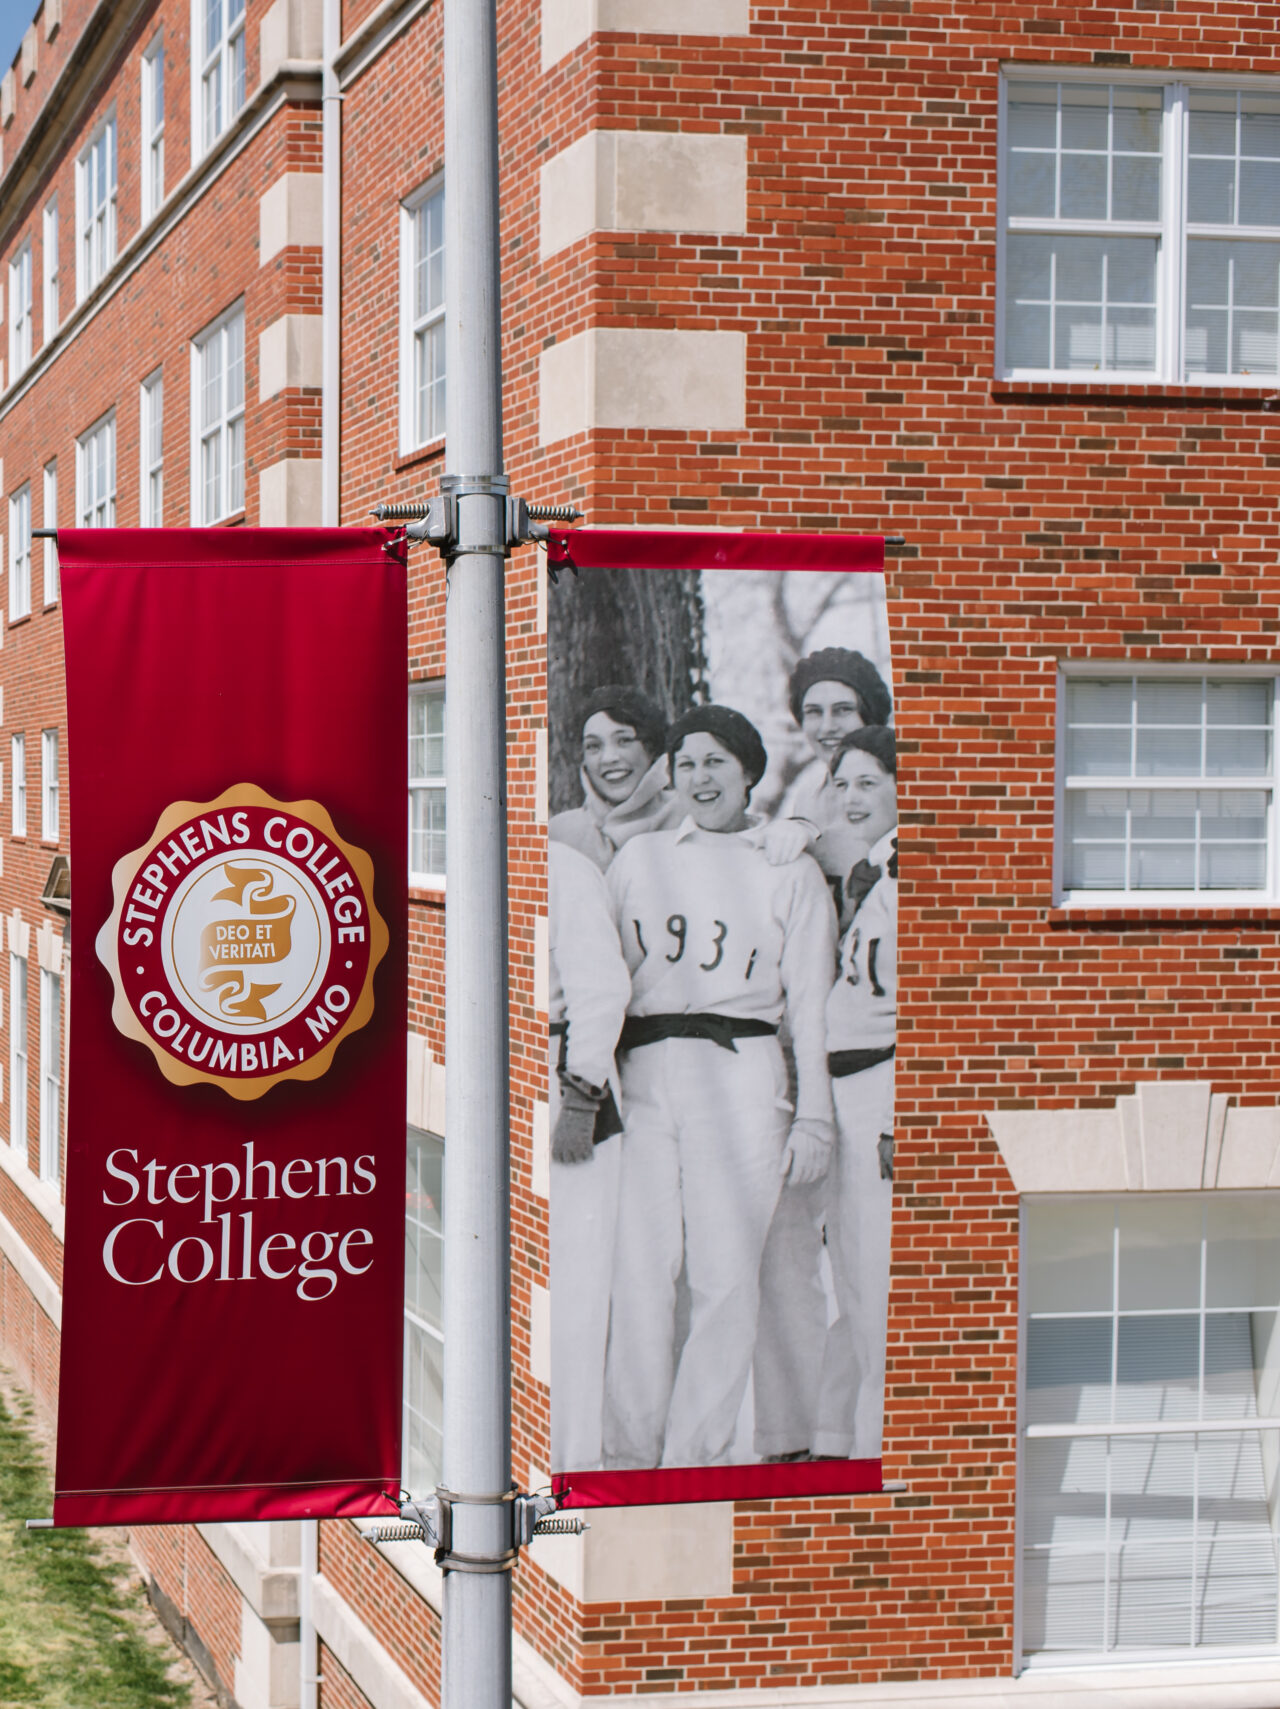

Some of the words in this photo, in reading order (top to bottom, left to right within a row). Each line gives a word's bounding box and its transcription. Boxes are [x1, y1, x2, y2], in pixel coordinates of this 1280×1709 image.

[123, 812, 250, 947] STEPHENS
[264, 817, 365, 944] COLLEGE
[209, 942, 276, 960] VERITATI
[216, 925, 250, 941] DEO
[256, 924, 272, 940] ET
[632, 914, 757, 980] 1931
[139, 990, 305, 1072] COLUMBIA,
[305, 984, 351, 1042] MO
[102, 1141, 377, 1223] Stephens
[102, 1211, 374, 1301] College
